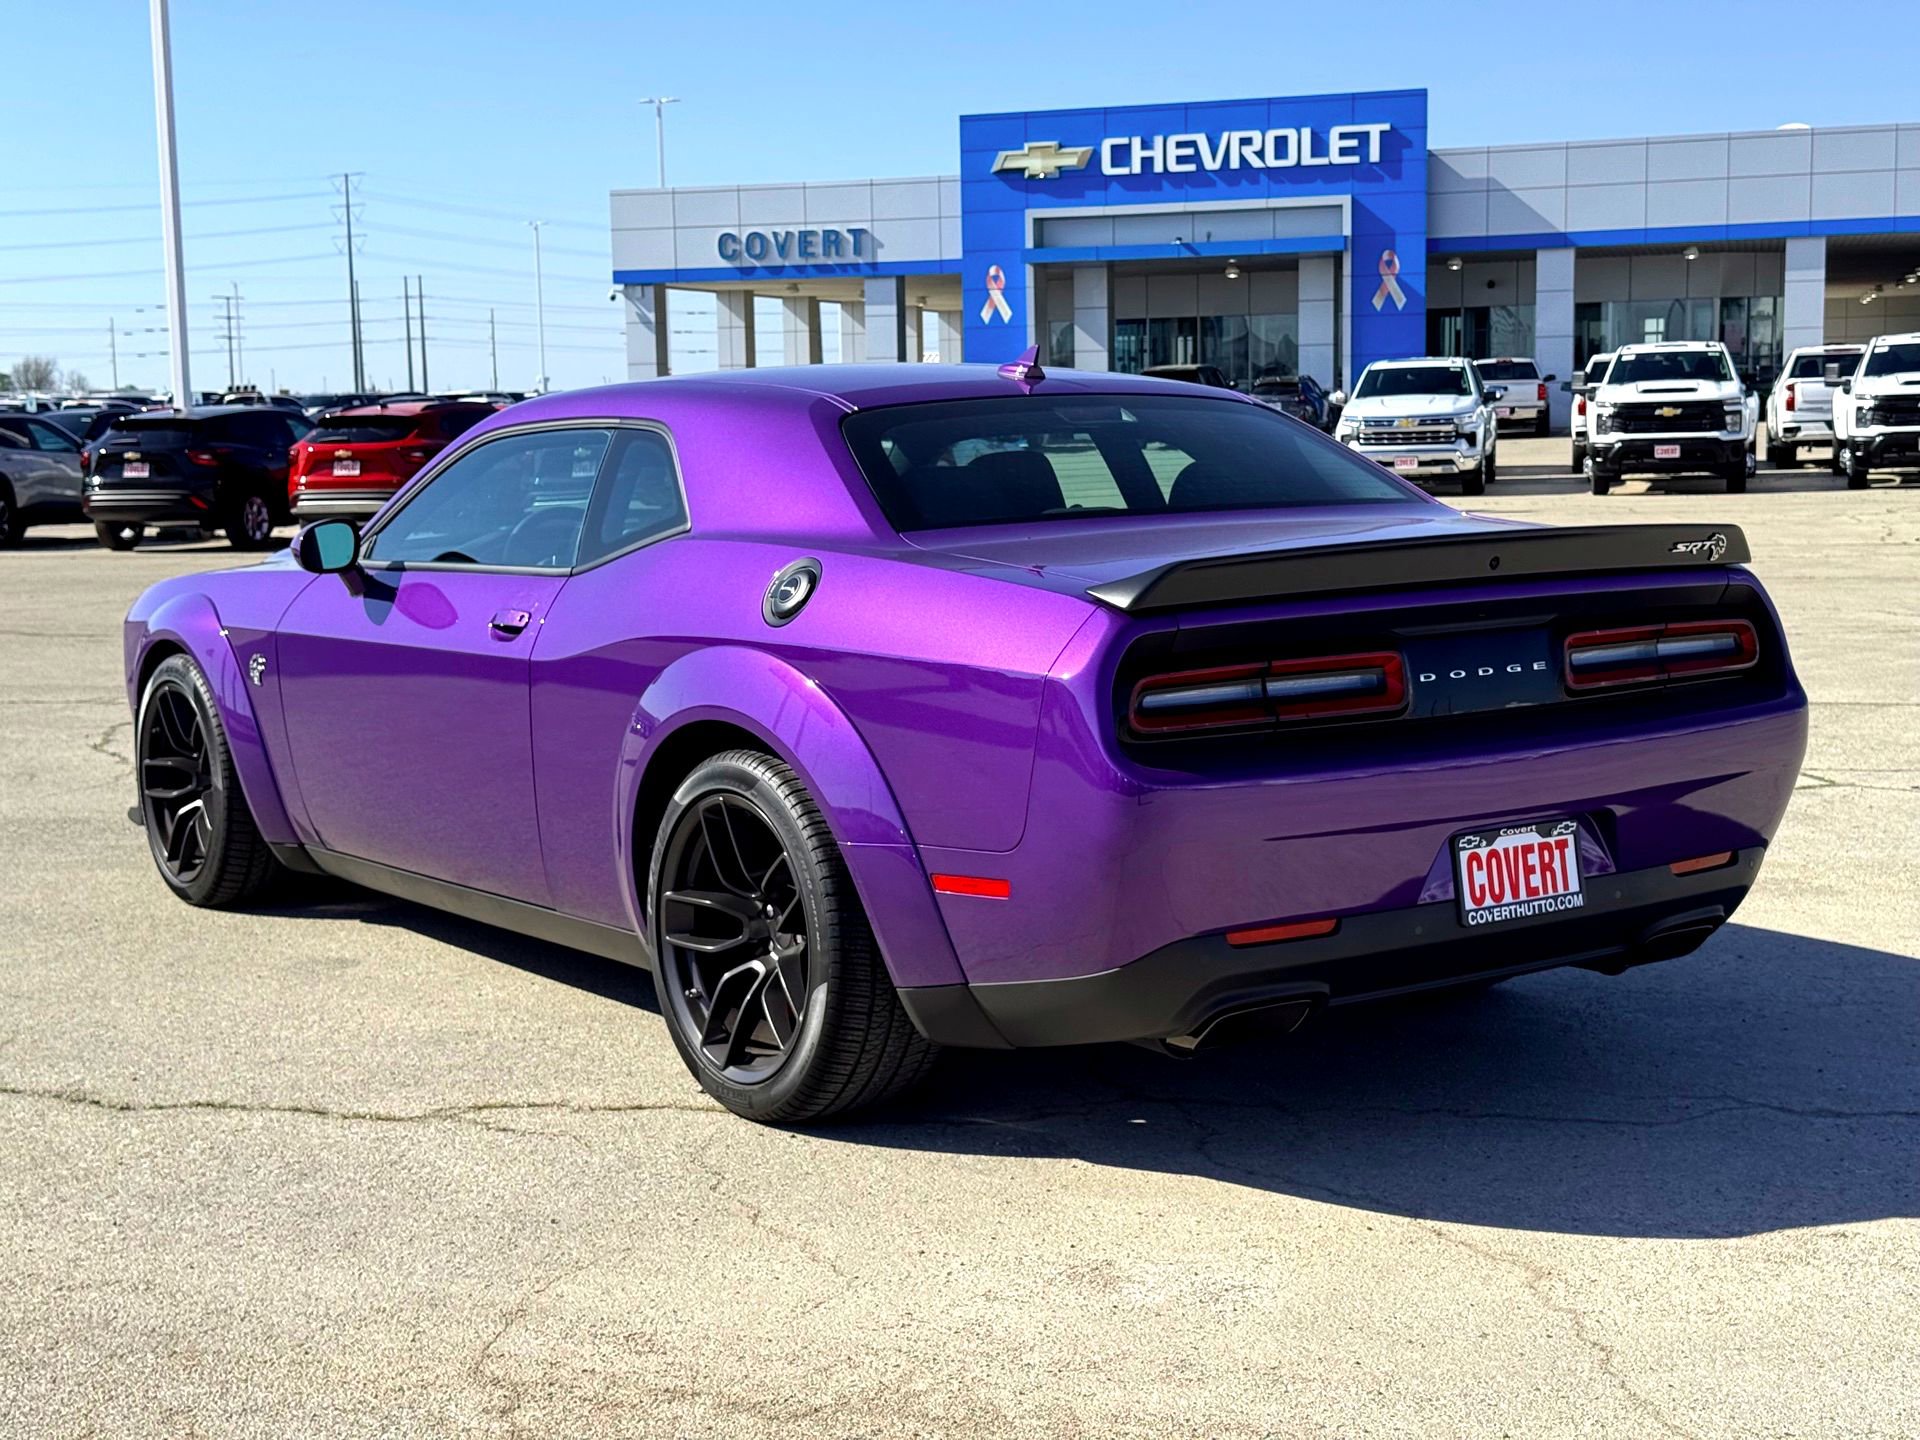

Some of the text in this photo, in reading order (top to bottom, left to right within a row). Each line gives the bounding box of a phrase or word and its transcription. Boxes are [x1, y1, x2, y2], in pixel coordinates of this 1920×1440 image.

[1100, 122, 1391, 176] CHEVROLET
[718, 228, 867, 262] COVERT
[1672, 541, 1716, 554] SRT
[1419, 661, 1547, 682] DODGE
[1500, 825, 1537, 836] Covert
[1466, 838, 1570, 908] COVERT
[1468, 894, 1584, 926] COVERTHUTTO.COM
